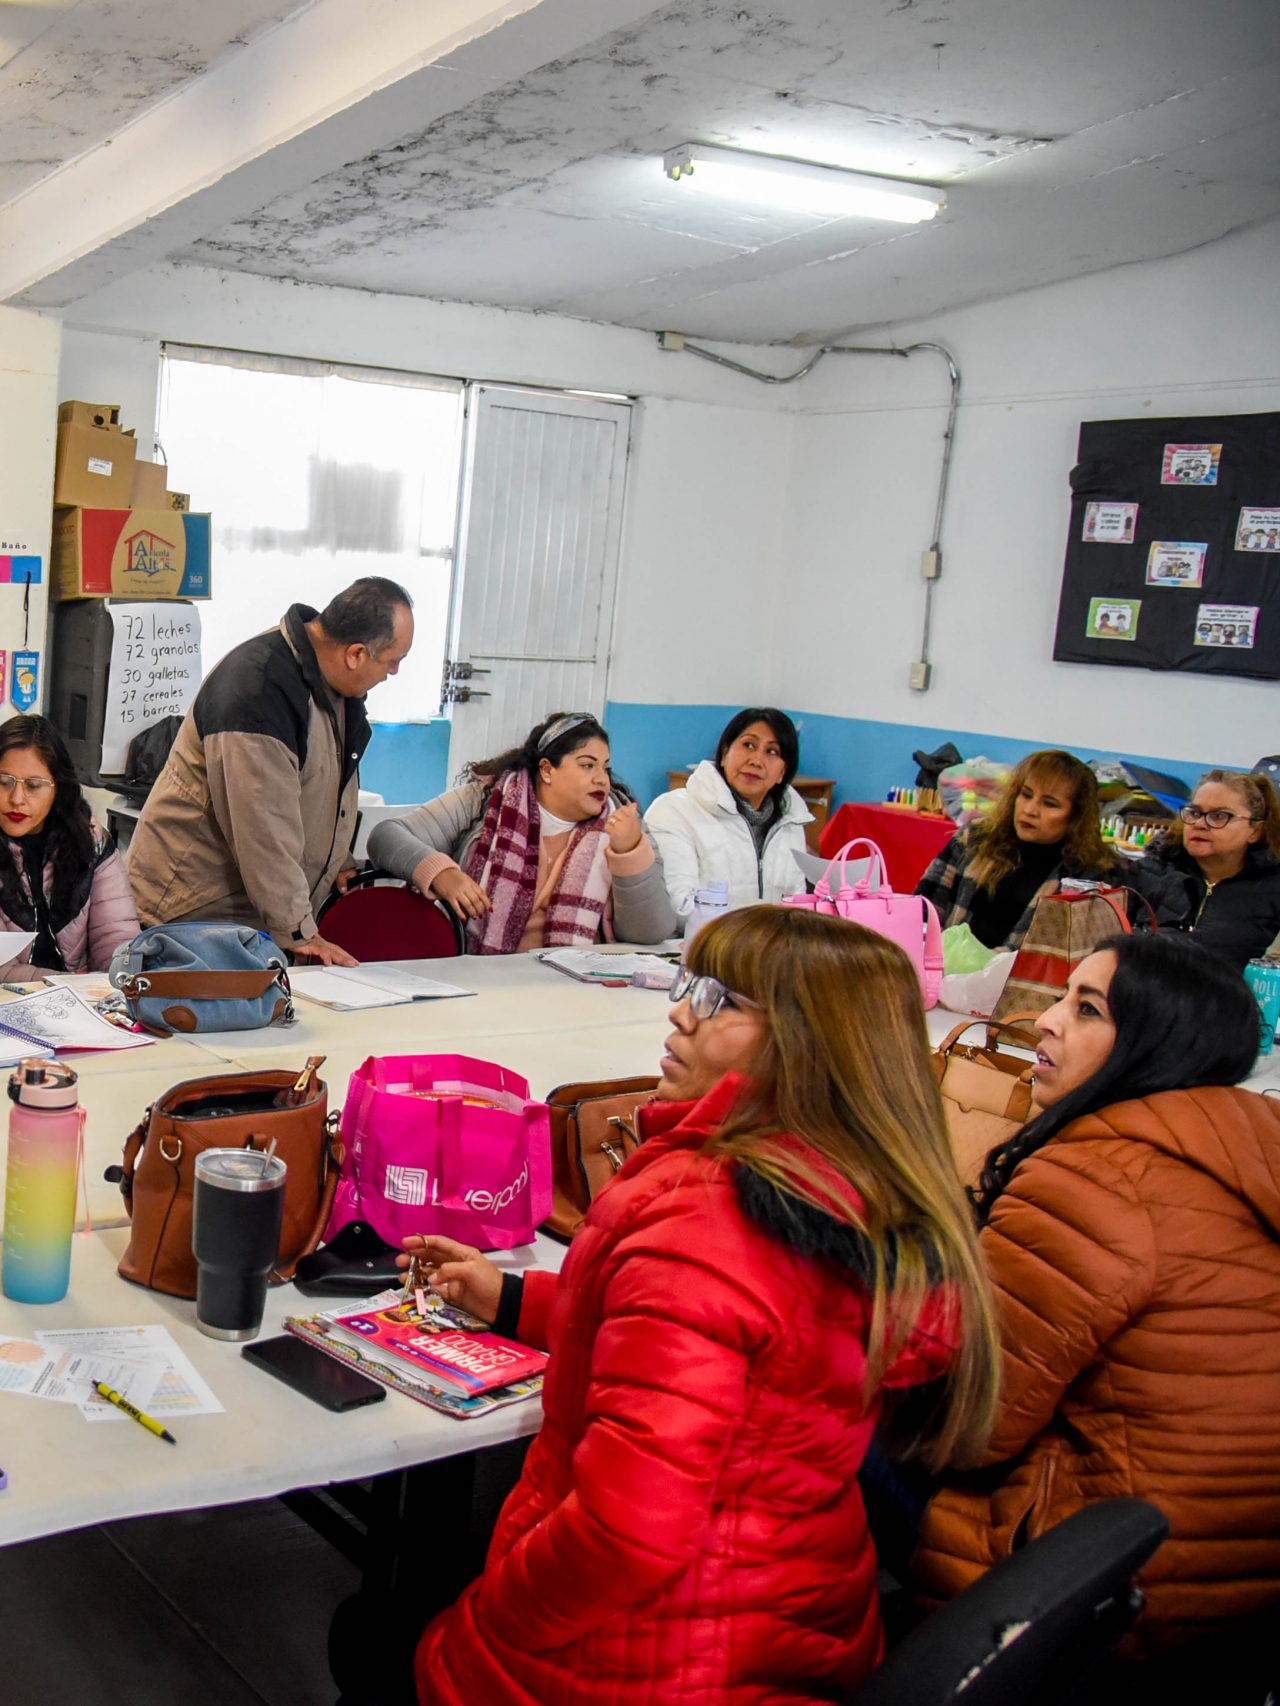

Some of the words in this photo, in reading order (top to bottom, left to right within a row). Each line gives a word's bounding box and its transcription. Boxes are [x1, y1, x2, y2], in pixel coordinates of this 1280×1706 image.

[1, 541, 27, 550] Baño
[121, 615, 145, 640] 72
[153, 613, 192, 640] leches
[125, 643, 145, 661] 72
[121, 668, 142, 684] 30
[145, 666, 190, 688] galletas
[121, 690, 137, 704] 27
[143, 684, 184, 703] cereales
[120, 709, 135, 723] 15
[143, 704, 181, 719] barras
[408, 1335, 496, 1374] PRIMER
[440, 1334, 516, 1366] GRADO
